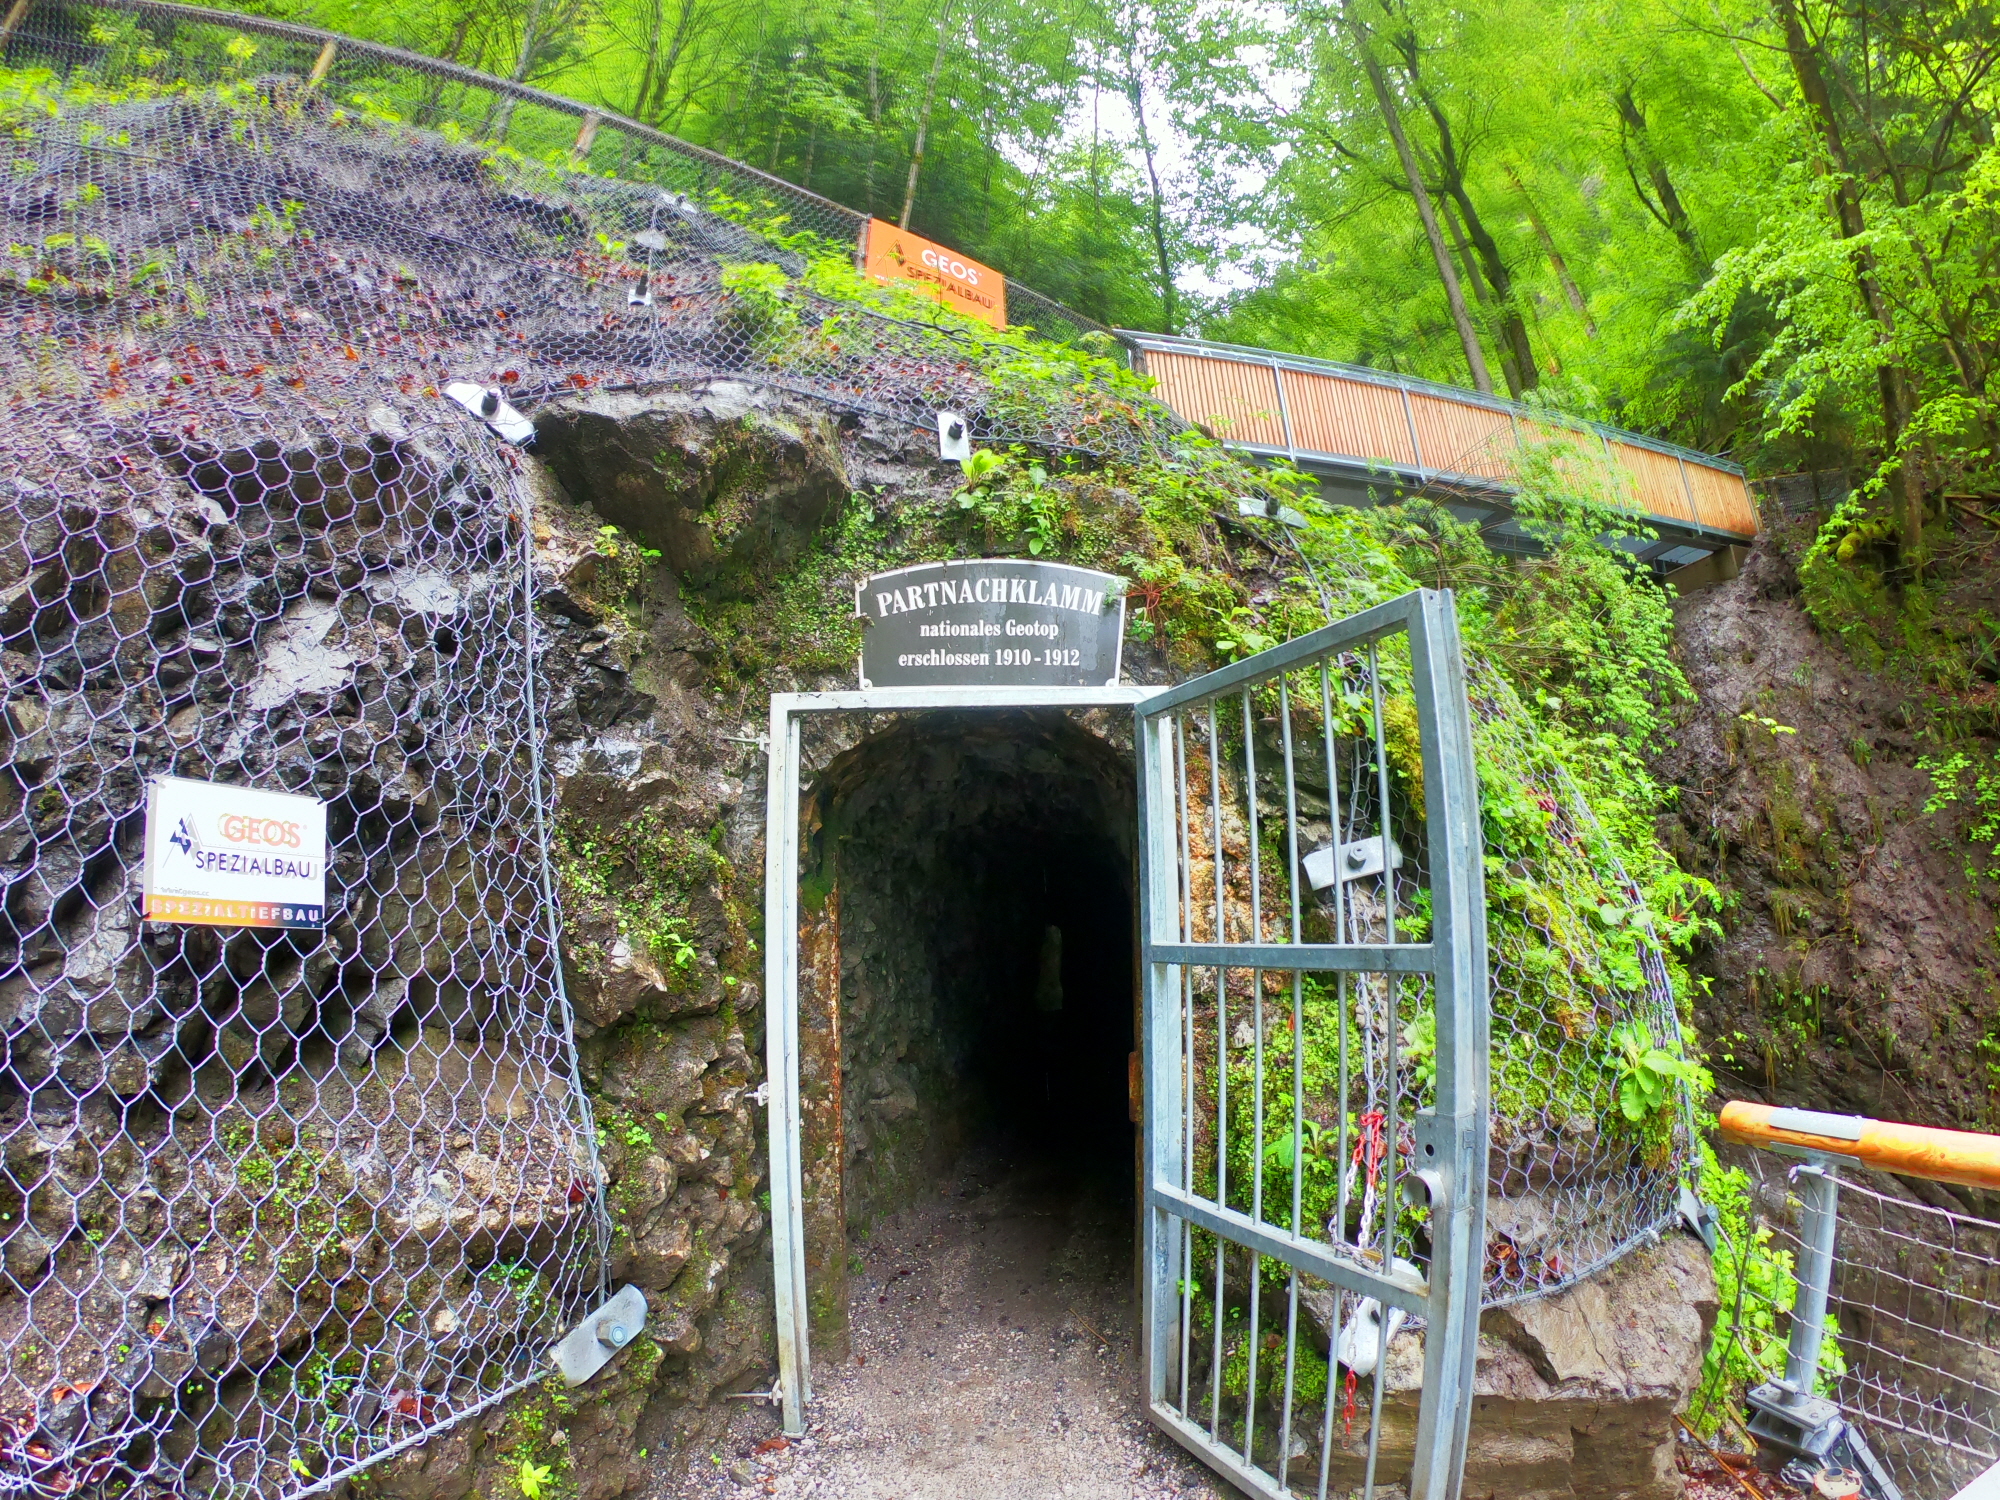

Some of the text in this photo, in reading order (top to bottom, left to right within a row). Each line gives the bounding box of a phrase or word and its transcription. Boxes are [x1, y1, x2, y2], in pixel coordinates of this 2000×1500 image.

[921, 249, 979, 285] GEOS
[876, 577, 1104, 617] PARTNACHKLAMM
[919, 619, 1059, 639] nationales Geotop
[898, 649, 989, 666] erschlossen
[219, 813, 301, 848] GEOS
[195, 850, 312, 878] SPEZIALBAU
[151, 898, 319, 922] SPEZIALTIEFBAU
